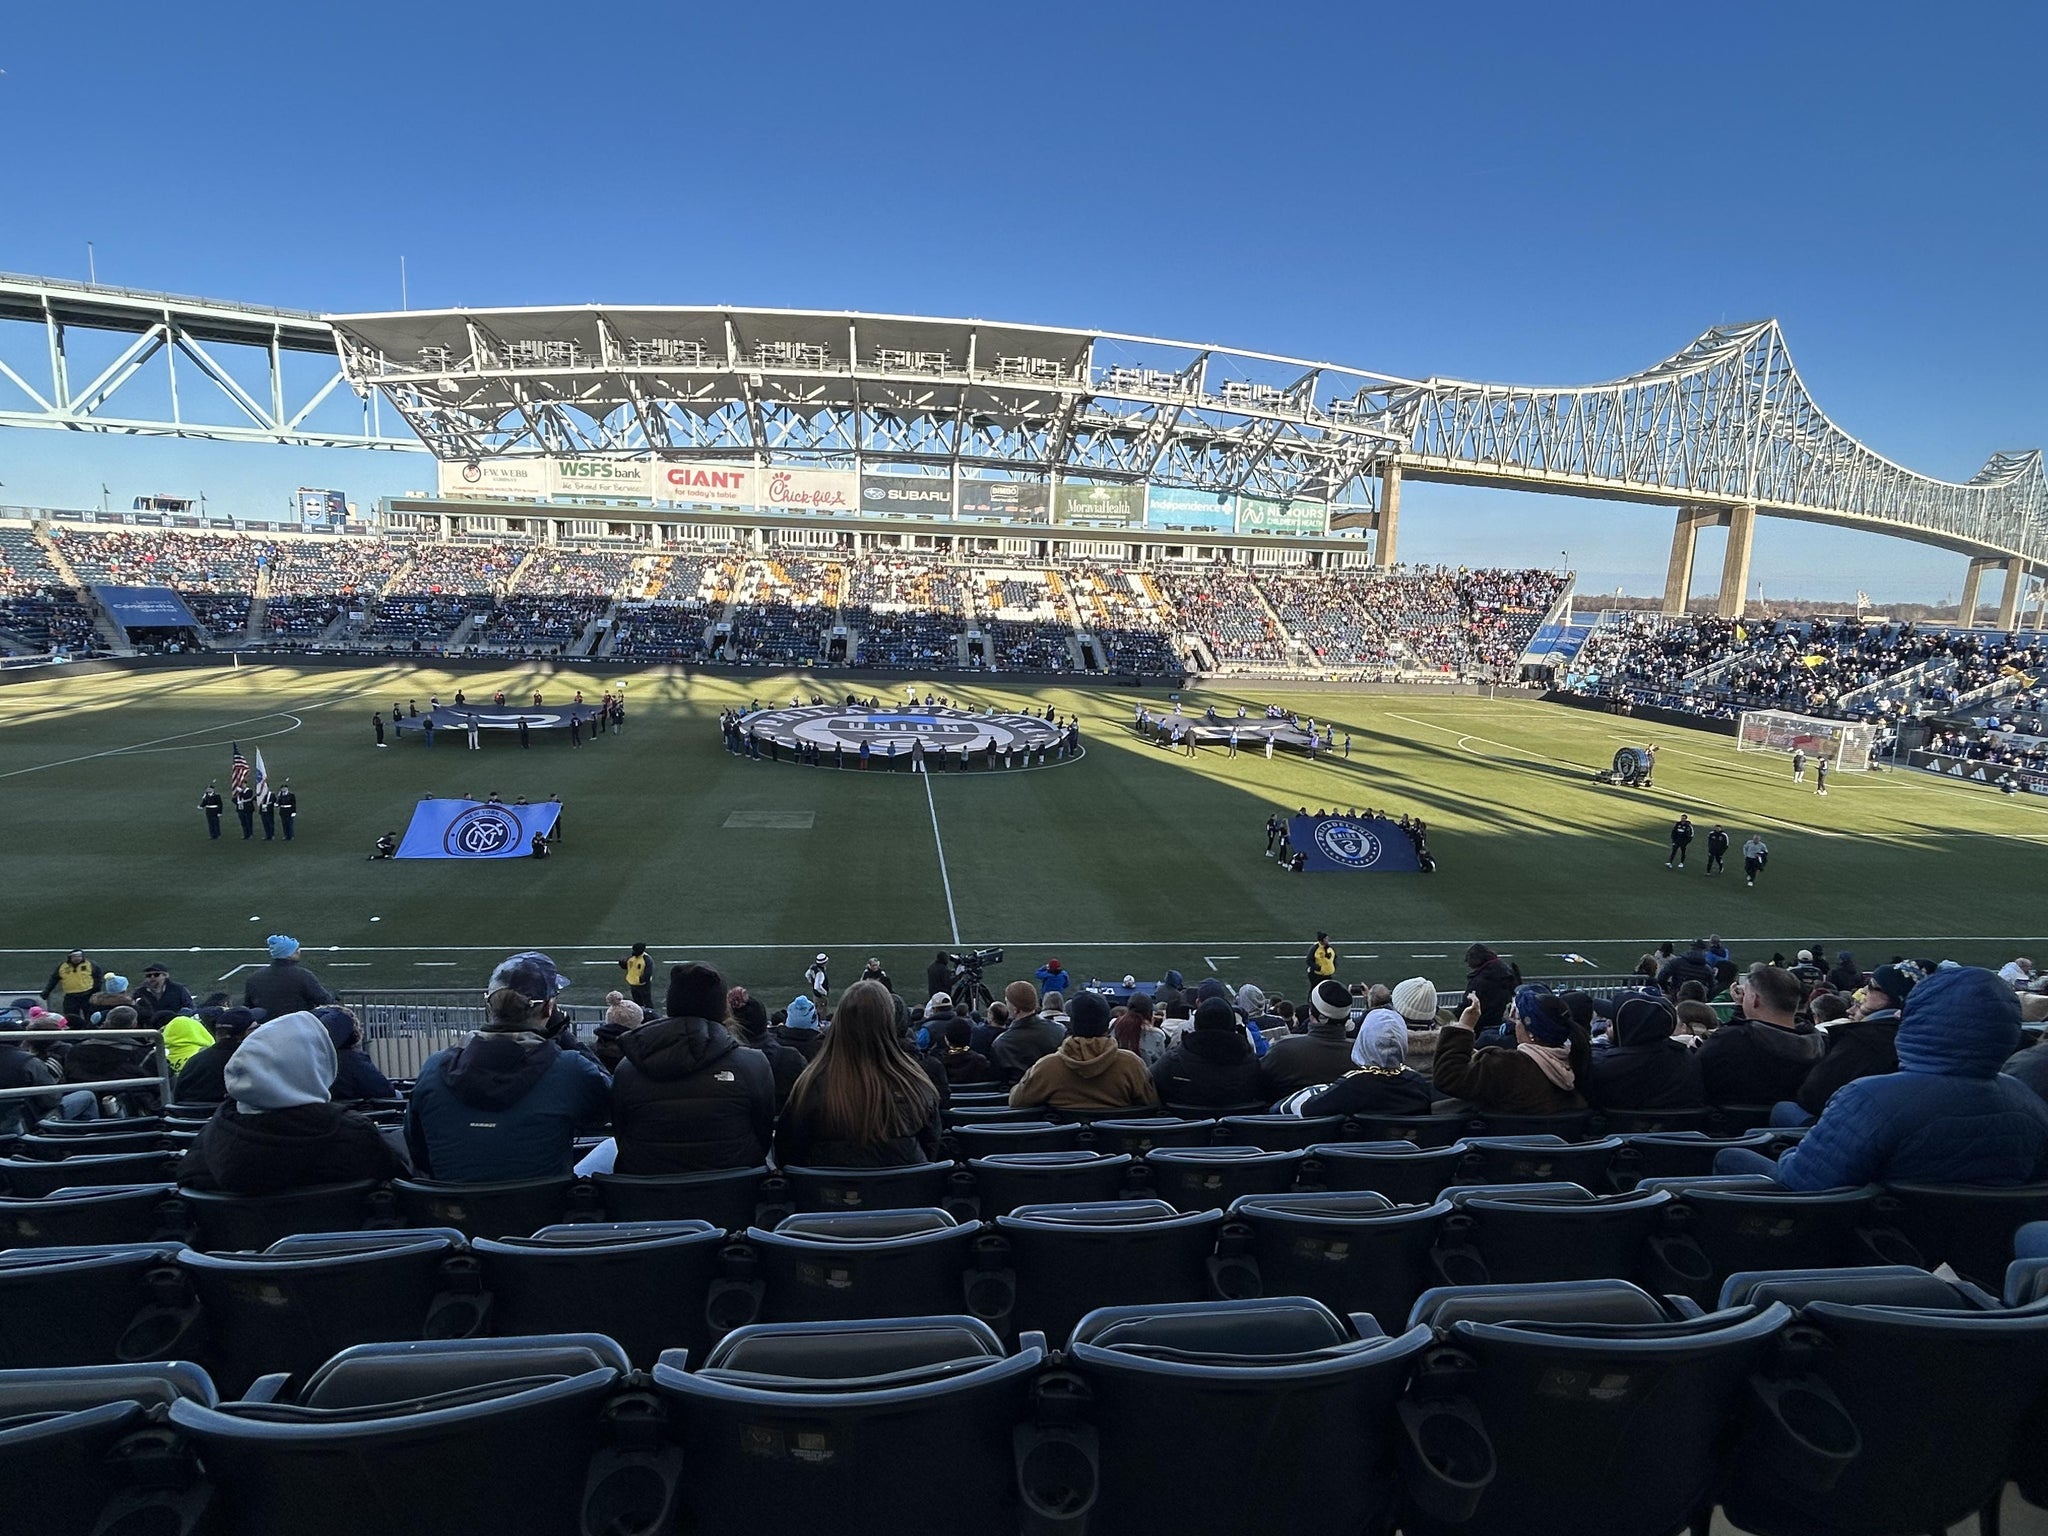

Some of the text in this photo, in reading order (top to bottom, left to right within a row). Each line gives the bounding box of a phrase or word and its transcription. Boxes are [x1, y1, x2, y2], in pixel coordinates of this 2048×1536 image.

[501, 469, 528, 478] WEBB
[559, 461, 641, 478] WSFS bank
[667, 468, 745, 489] GIANT
[674, 488, 686, 496] for
[717, 491, 737, 499] table
[768, 478, 847, 507] Chick-fil-A
[887, 489, 952, 503] SUBARU
[754, 704, 1047, 734] PHILADELPHIA
[849, 721, 960, 733] UNION
[464, 811, 479, 821] NEW
[500, 813, 513, 824] CITY
[1318, 822, 1374, 841] PHILADELPHIA
